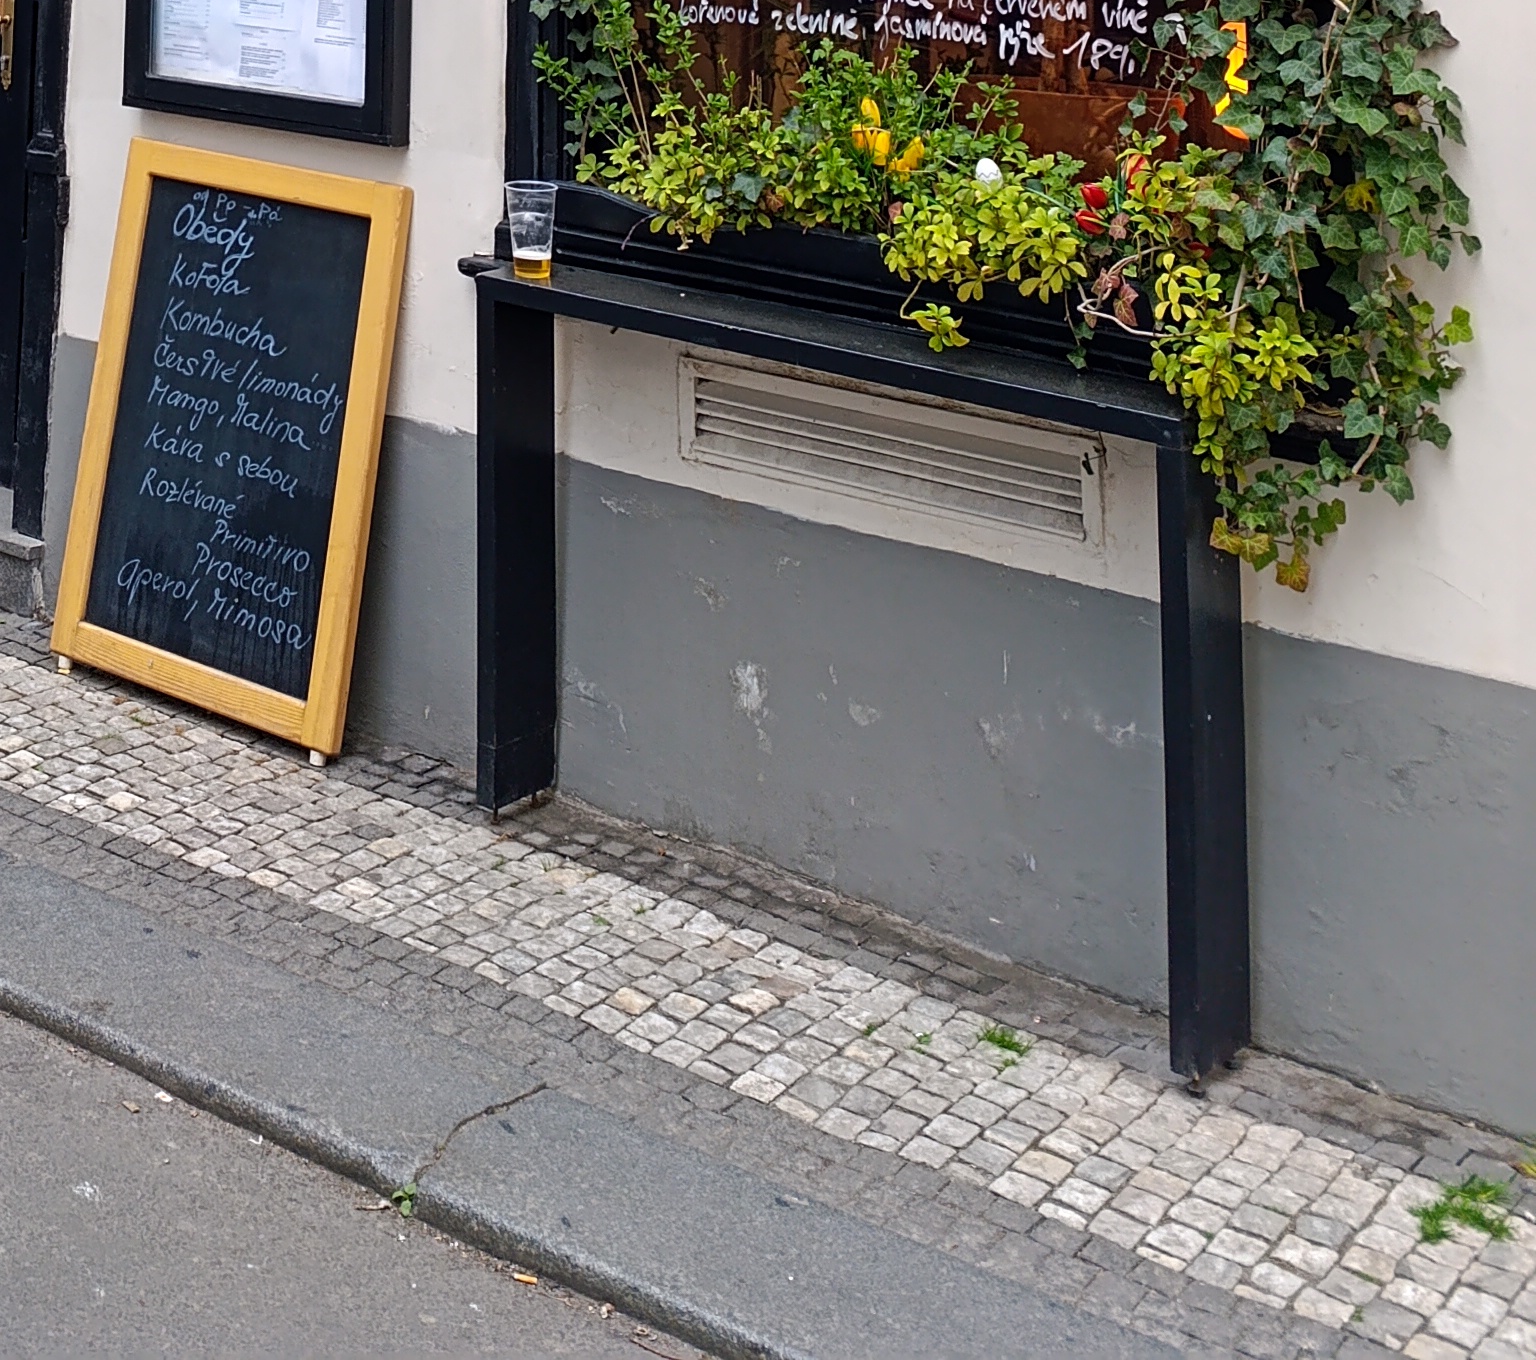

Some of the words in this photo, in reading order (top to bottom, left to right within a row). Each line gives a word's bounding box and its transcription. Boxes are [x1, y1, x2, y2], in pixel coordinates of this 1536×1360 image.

[160, 296, 287, 356] Kombucha
[238, 360, 344, 434] limonády
[215, 451, 230, 468] s
[237, 454, 299, 498] sebou
[192, 543, 297, 607] Prosecco
